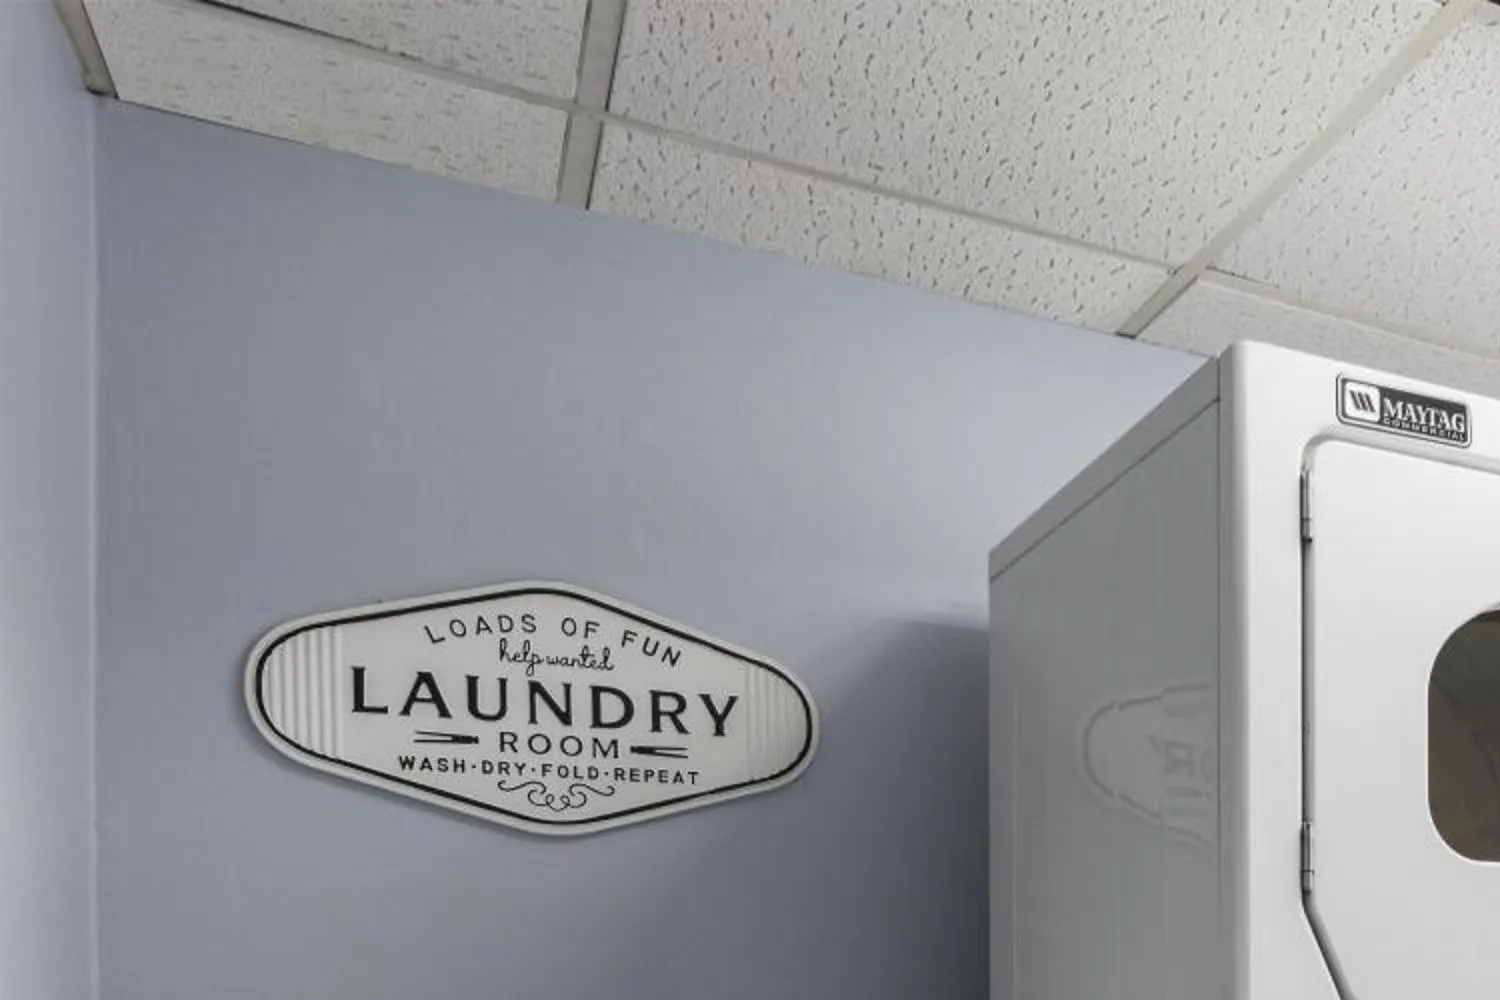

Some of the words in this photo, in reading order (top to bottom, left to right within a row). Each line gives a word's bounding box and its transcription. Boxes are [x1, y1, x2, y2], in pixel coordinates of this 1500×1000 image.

[1384, 397, 1465, 433] MAYTAG
[1384, 417, 1465, 442] COMMERCIAL
[423, 613, 537, 645] LOADS
[560, 616, 601, 639] OF
[620, 629, 681, 668] FUN
[499, 637, 545, 677] help
[545, 645, 615, 672] wanted
[351, 666, 740, 738] LAUNDRY
[499, 731, 620, 759] ROOM
[399, 755, 466, 773] WASH
[481, 760, 528, 777] DRY
[540, 763, 601, 781] FOLD
[613, 767, 700, 786] REPEAT
